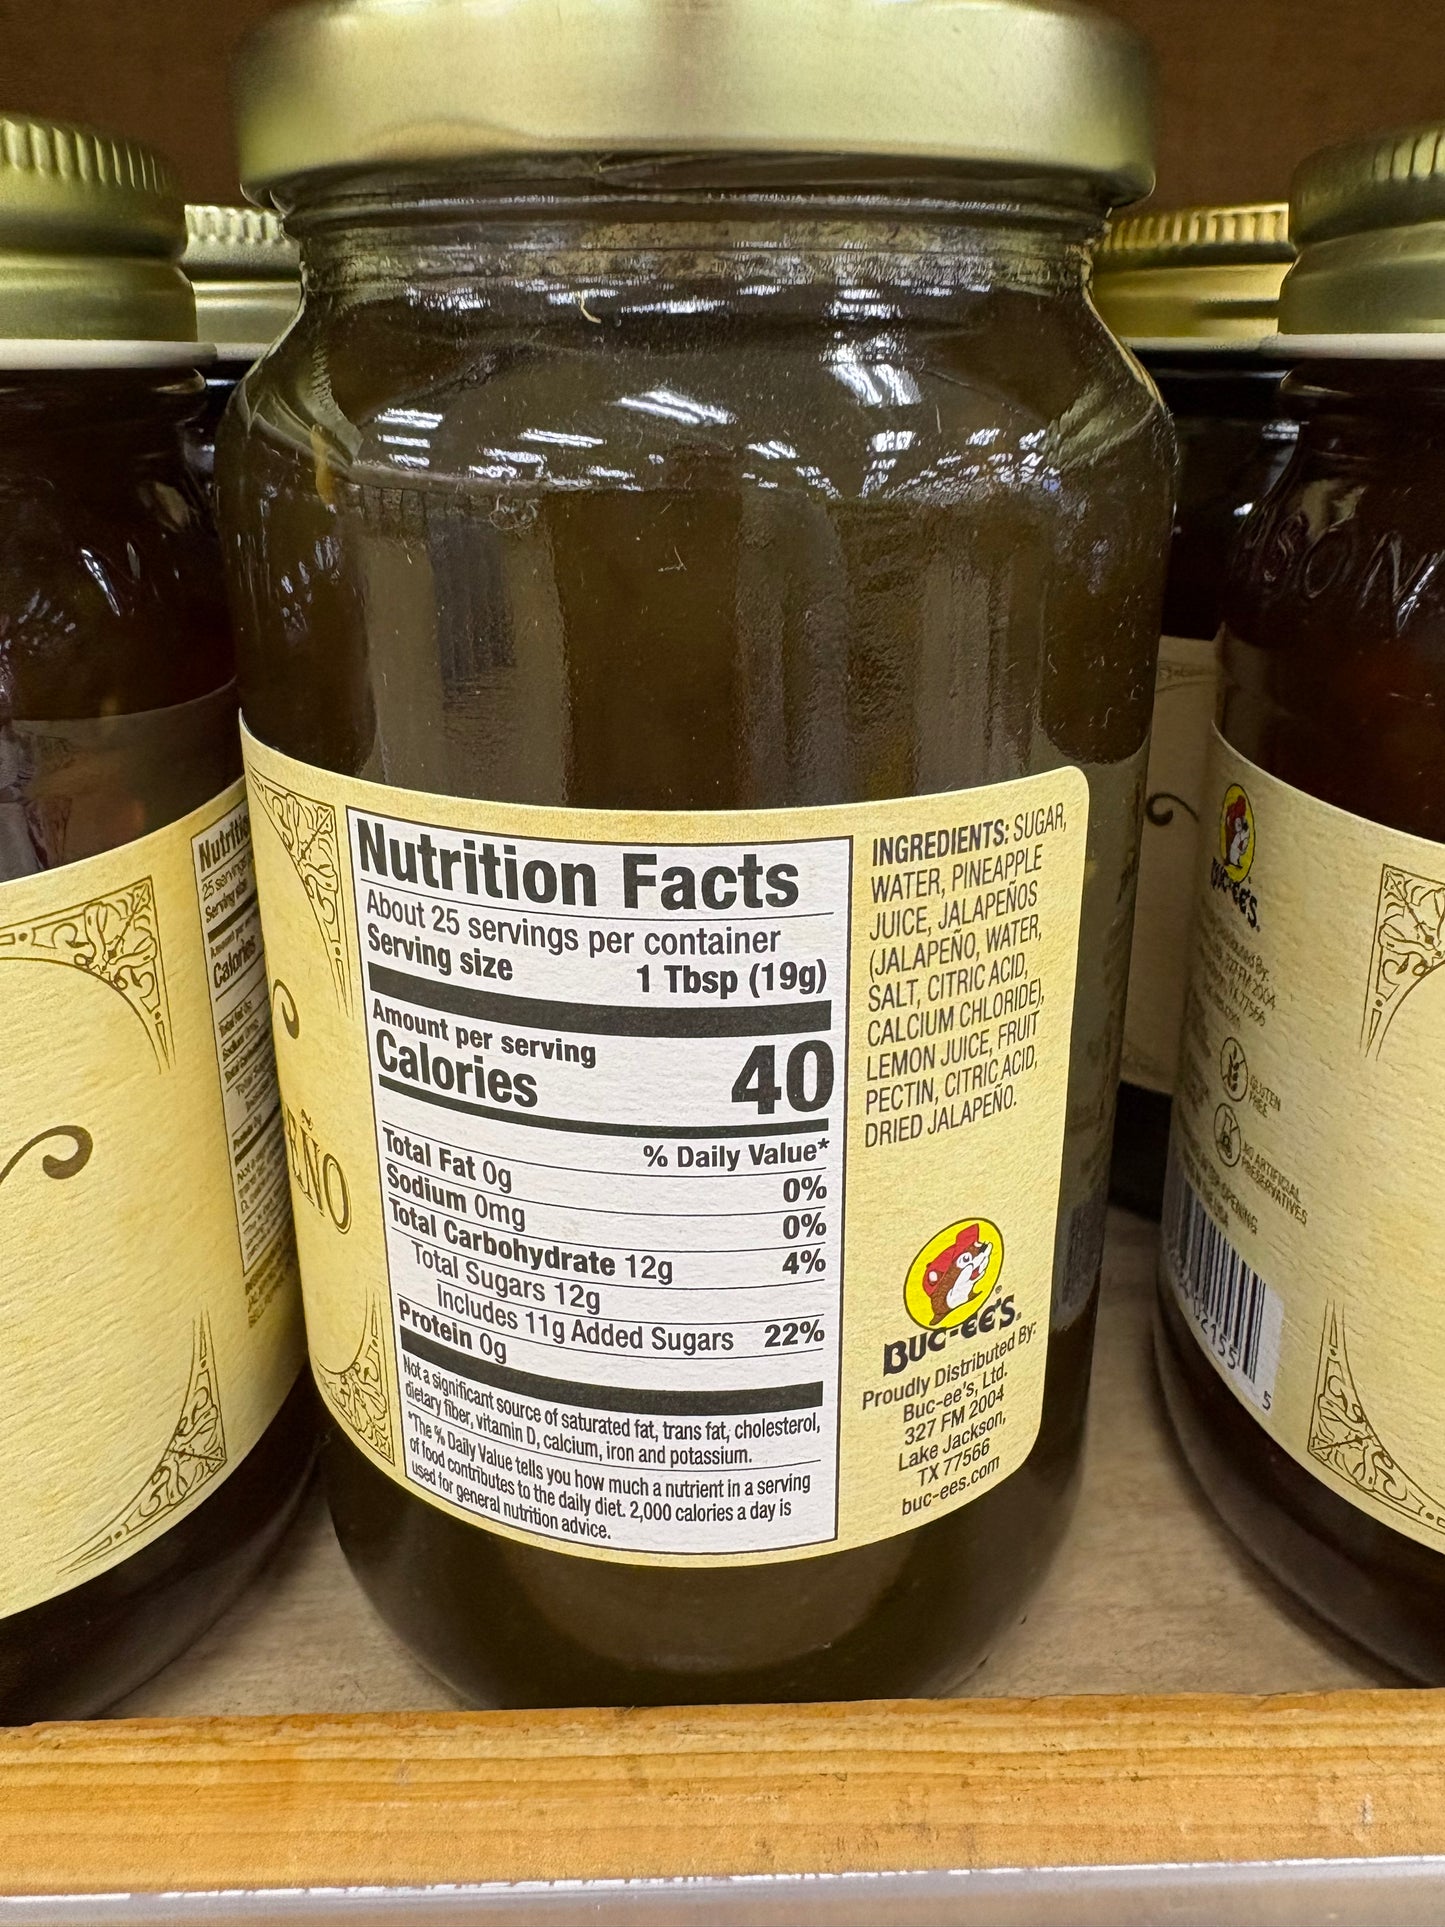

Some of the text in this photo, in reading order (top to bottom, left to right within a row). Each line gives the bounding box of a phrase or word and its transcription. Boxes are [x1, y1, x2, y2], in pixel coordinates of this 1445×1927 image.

[357, 818, 799, 911] Nutrition Facts
[872, 802, 1066, 867] INGREDIENTS: SUGAR,
[871, 843, 1043, 904] WATER, PINEAPPLE
[367, 889, 781, 958] About 25 servings per container
[869, 880, 1038, 941] JUICE, JALAPEÑOS
[367, 922, 827, 1000] Serving size 1 Tbsp (19g)
[868, 952, 1028, 1012] SALT, CITRIC ACID,
[869, 914, 1042, 983] (JALAPEÑO, WATER,
[373, 998, 596, 1069] Amount per serving
[867, 978, 1044, 1047] CALCIUM CHLORIDE),
[867, 1010, 1040, 1082] LEMON JUICE, FRUIT
[376, 1029, 834, 1115] Calories 40
[866, 1044, 1037, 1115] PECTIN, CITRIC ACID,
[865, 1082, 1017, 1148] DRIED JALAPEÑO.
[382, 1126, 827, 1203] Total Fat 0g 0%
[643, 1145, 668, 1167] %
[677, 1145, 741, 1172] Daily
[387, 1163, 827, 1240] Sodium 0mg 0%
[388, 1197, 826, 1286] Total Carbohydrate 12g 4%
[411, 1240, 600, 1315] Total Sugars 12g
[398, 1298, 507, 1365] Protein 0g
[437, 1283, 825, 1356] Includes 11g Added Sugars 22%
[403, 1354, 820, 1444] Not a significant source of saturated fat, trans fat, cholesterol,
[862, 1321, 1037, 1411] Proudly Distributed By:
[903, 1361, 1008, 1423] Buc-ee's, Ltd.
[406, 1382, 752, 1468] dietary fiber, vitamin D, calcium, iron and potassium.
[898, 1411, 1006, 1472] Lake Jackson,
[905, 1384, 1004, 1446] 327 FM 2004
[410, 1437, 792, 1523] of food contributes to the daily diet. 2,000 calories a day is
[434, 1425, 446, 1446] %
[447, 1431, 476, 1462] Daily
[478, 1443, 513, 1472] Value
[515, 1456, 544, 1480] tells
[546, 1467, 571, 1486] you
[574, 1469, 605, 1491] how
[609, 1477, 649, 1496] much
[653, 1482, 662, 1497] a
[665, 1479, 724, 1498] nutrient
[727, 1479, 740, 1498] in
[744, 1481, 754, 1496] a
[757, 1473, 811, 1495] serving
[902, 1456, 1000, 1516] buc-ees.com
[917, 1438, 990, 1487] TX 77566
[412, 1460, 611, 1539] used for general nutrition advice.
